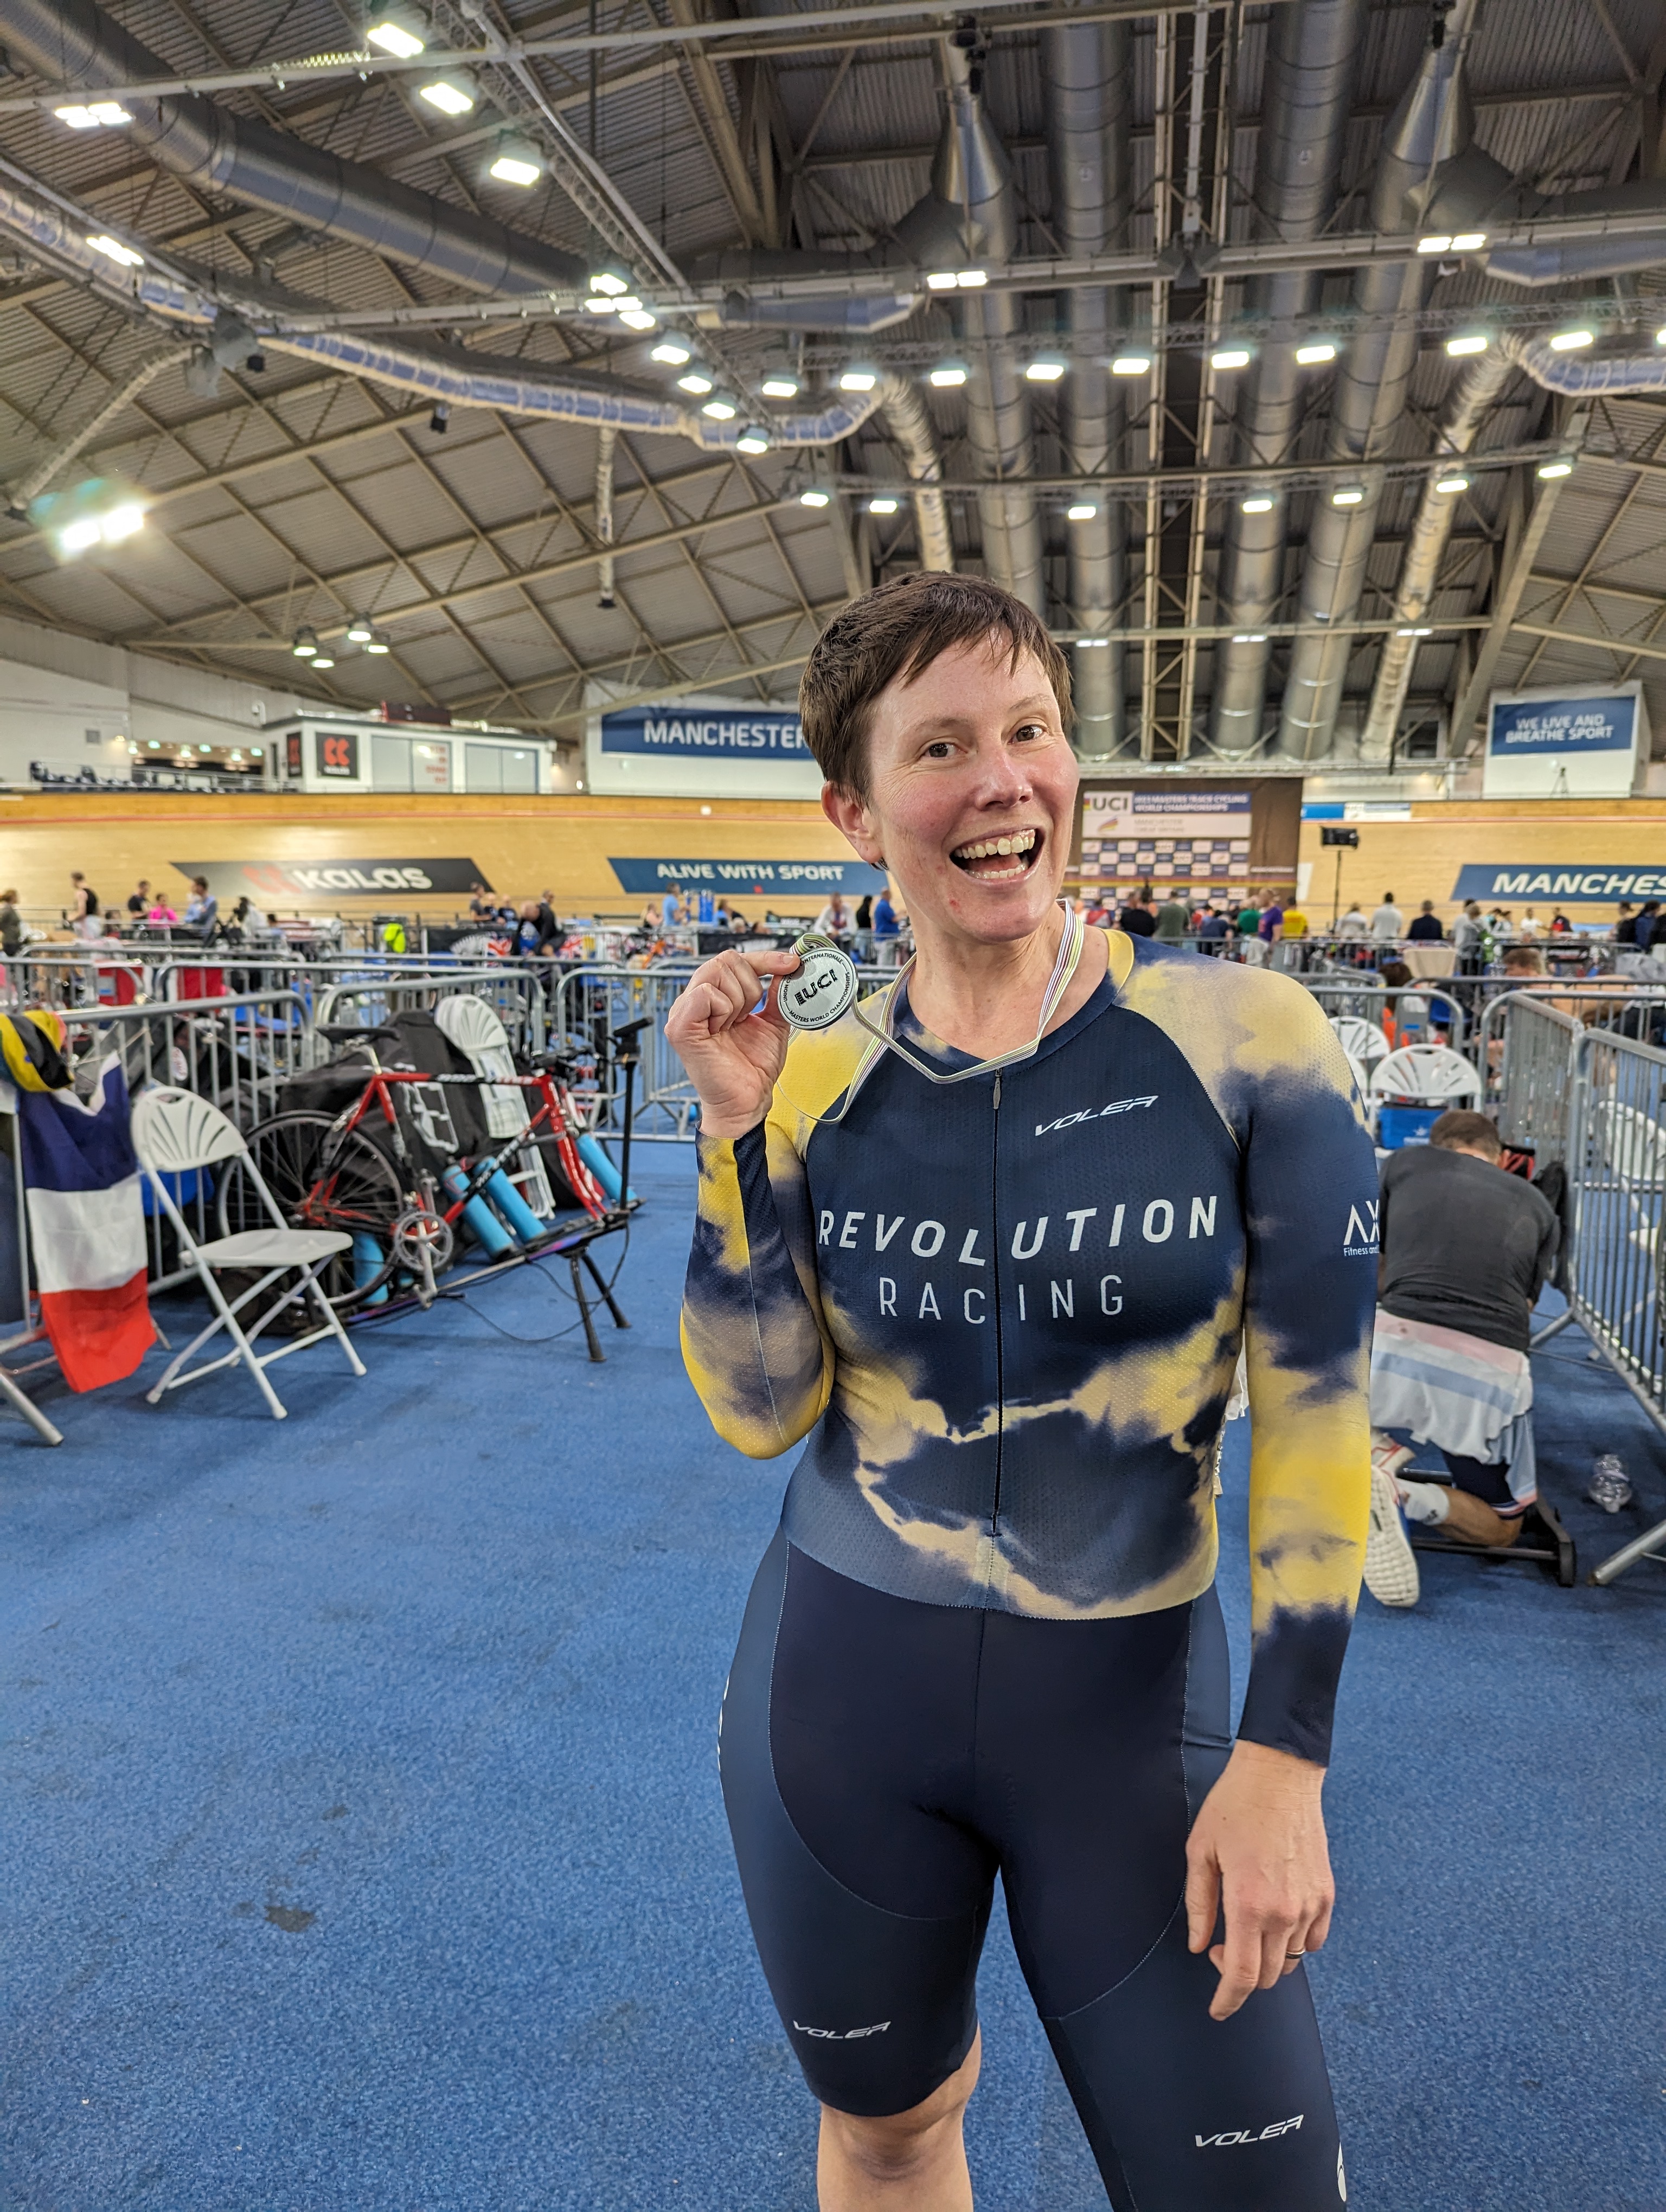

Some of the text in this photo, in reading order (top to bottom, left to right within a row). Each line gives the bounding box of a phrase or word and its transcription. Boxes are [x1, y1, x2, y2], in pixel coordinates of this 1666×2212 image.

[1516, 713, 1605, 730] WE LIVE AND
[1505, 725, 1614, 743] BREATHE SPORT
[1092, 796, 1128, 811] UCI
[657, 863, 845, 881] ALIVE WITH SPORT
[802, 953, 843, 964] INTERNATIONALE
[800, 968, 838, 999] UCI
[789, 971, 850, 1023] MASTERS WORLD CHAMPIONSHIPS
[1035, 1094, 1159, 1136] VOLER
[818, 1195, 1218, 1267] REVOLUTION
[1343, 1247, 1368, 1256] Fitness
[879, 1274, 1124, 1324] RACING
[792, 2020, 892, 2039] VOLER
[1195, 2114, 1304, 2147] VOLER
